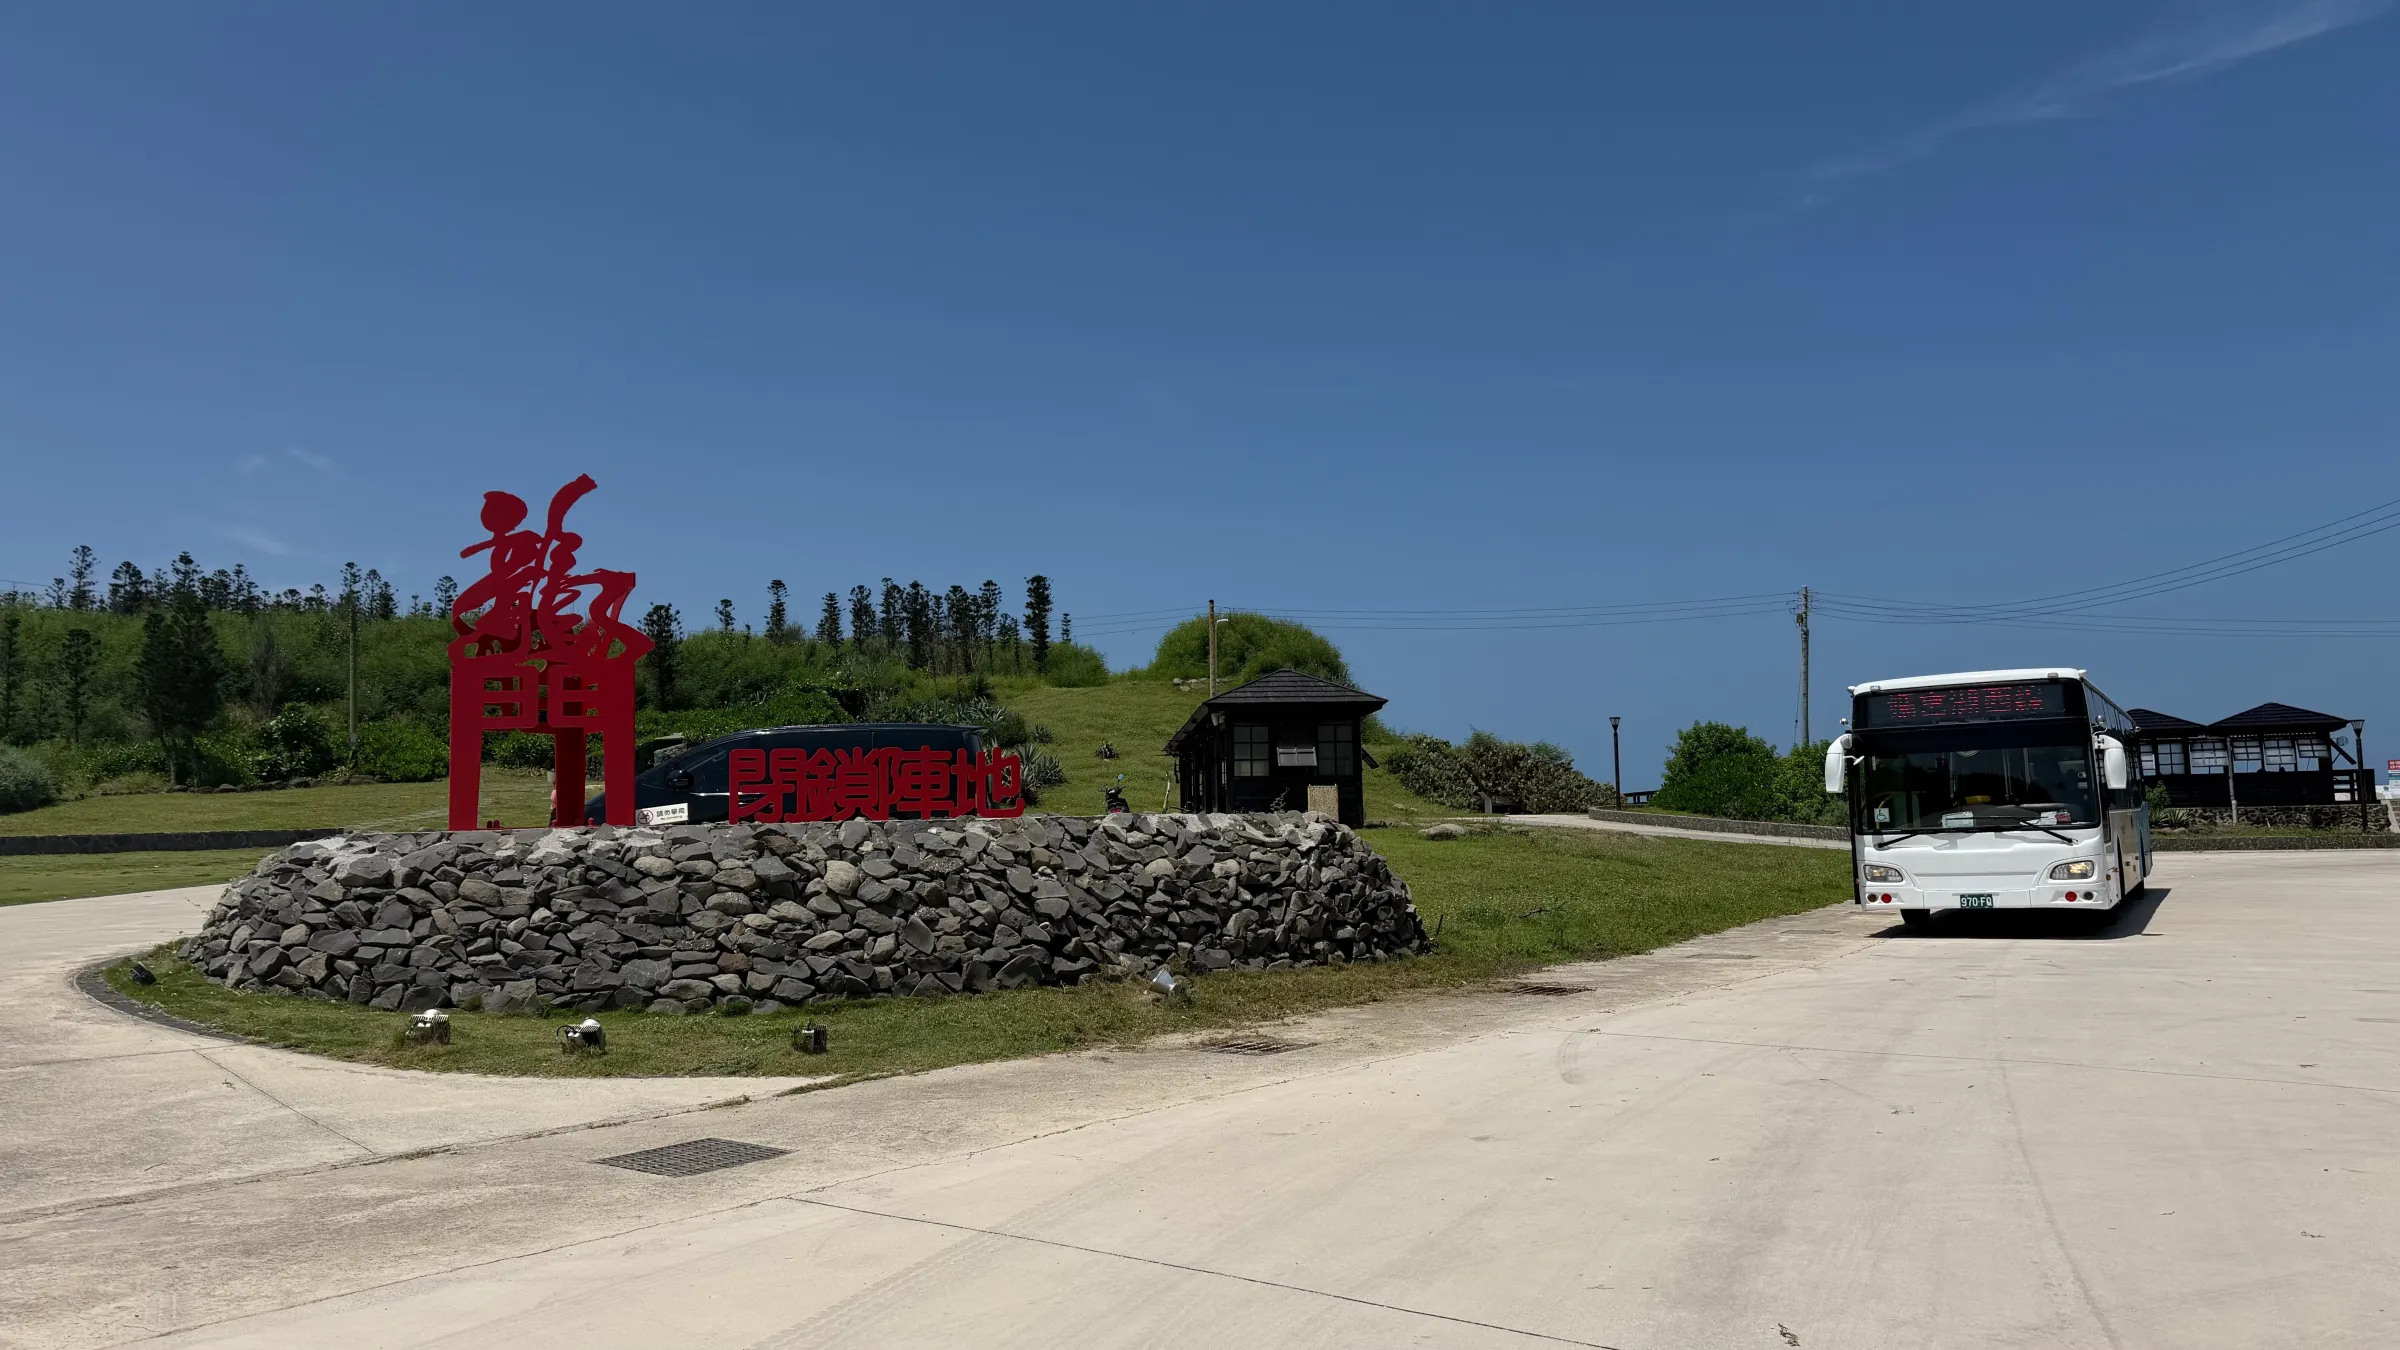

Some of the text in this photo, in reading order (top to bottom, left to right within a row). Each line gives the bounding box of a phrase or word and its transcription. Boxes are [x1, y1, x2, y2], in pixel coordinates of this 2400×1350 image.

[729, 745, 1025, 825] 閉鎖陣地
[1961, 896, 1993, 907] 970-FQ
